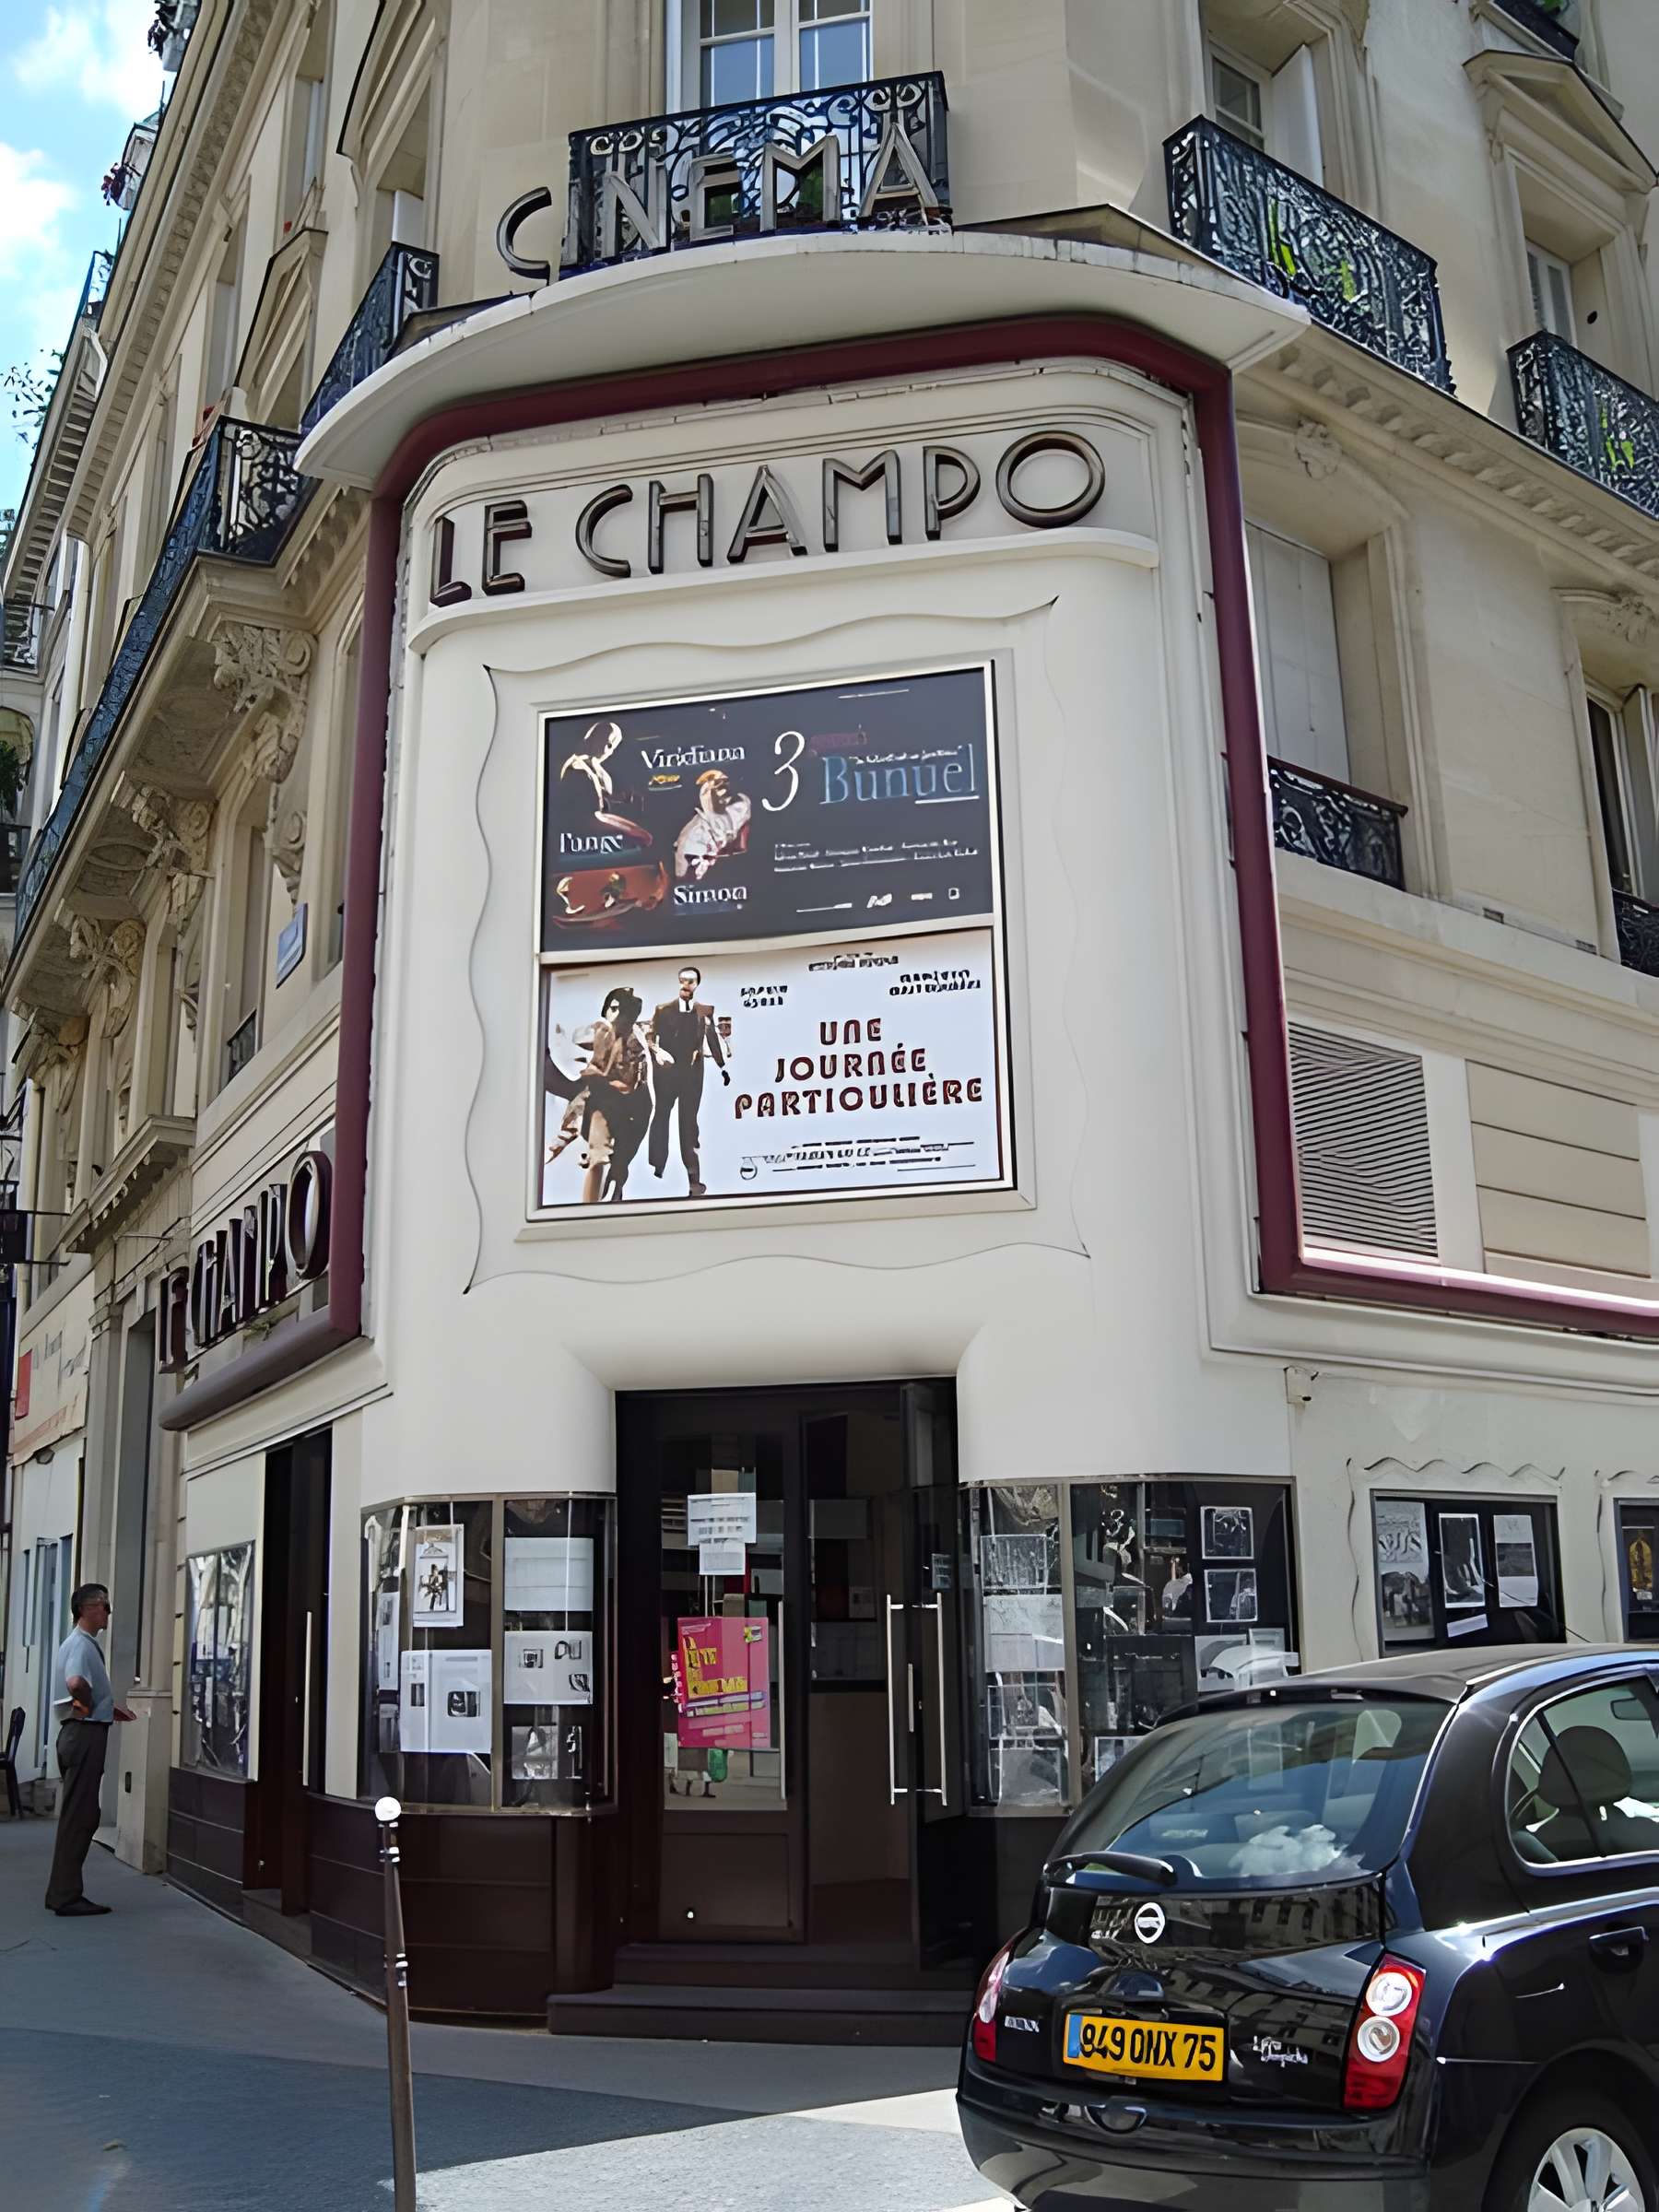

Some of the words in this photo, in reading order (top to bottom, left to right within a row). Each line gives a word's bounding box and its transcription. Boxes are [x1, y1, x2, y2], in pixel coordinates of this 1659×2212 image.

[430, 500, 532, 608] LE
[575, 429, 1106, 578] CHAMPO
[761, 731, 805, 811] 3
[819, 1018, 882, 1046] UNE
[774, 1042, 926, 1083] JOURNÉE
[1182, 2032, 1217, 2071] 75
